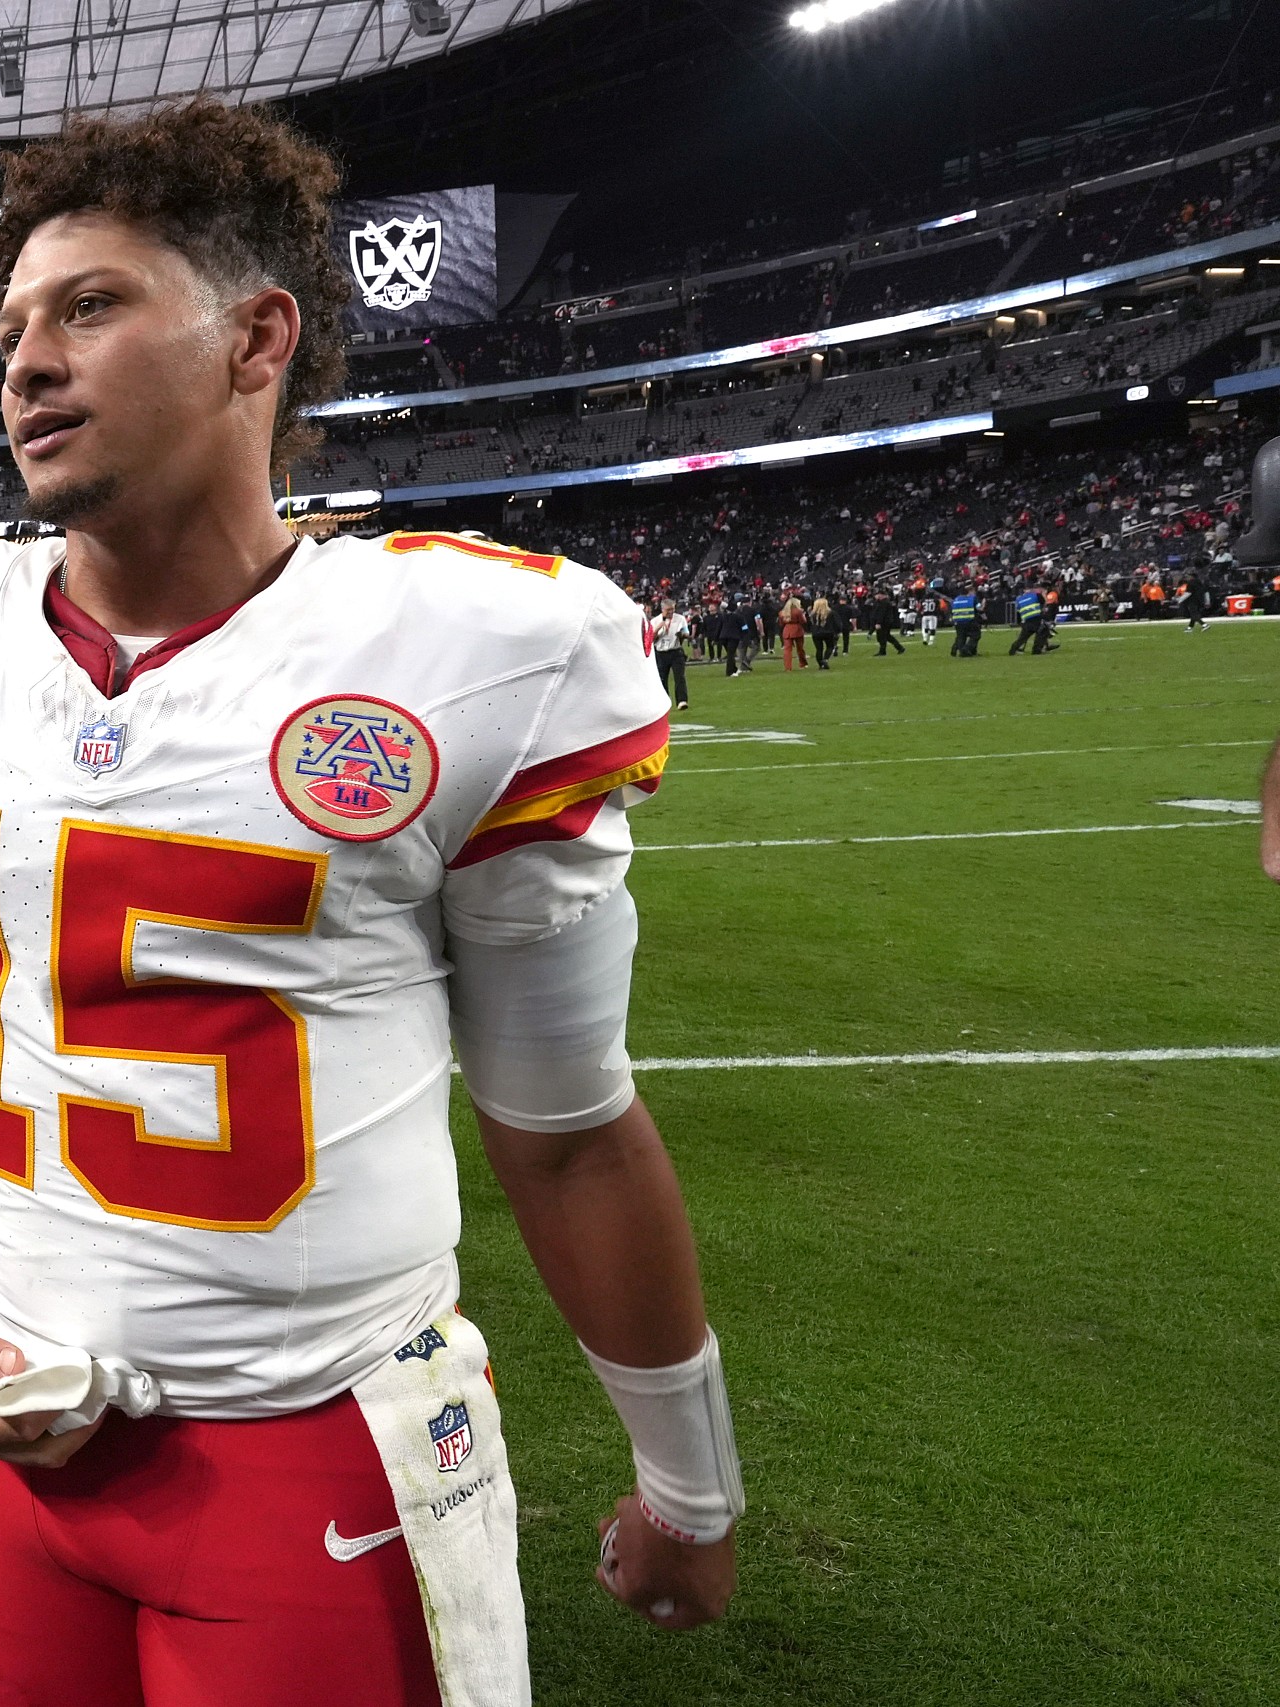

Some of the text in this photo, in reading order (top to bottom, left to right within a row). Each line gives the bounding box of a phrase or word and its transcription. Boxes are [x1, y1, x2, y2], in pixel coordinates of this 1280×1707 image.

[81, 742, 113, 765] NFL
[335, 786, 370, 807] LH
[436, 1429, 470, 1468] NFL
